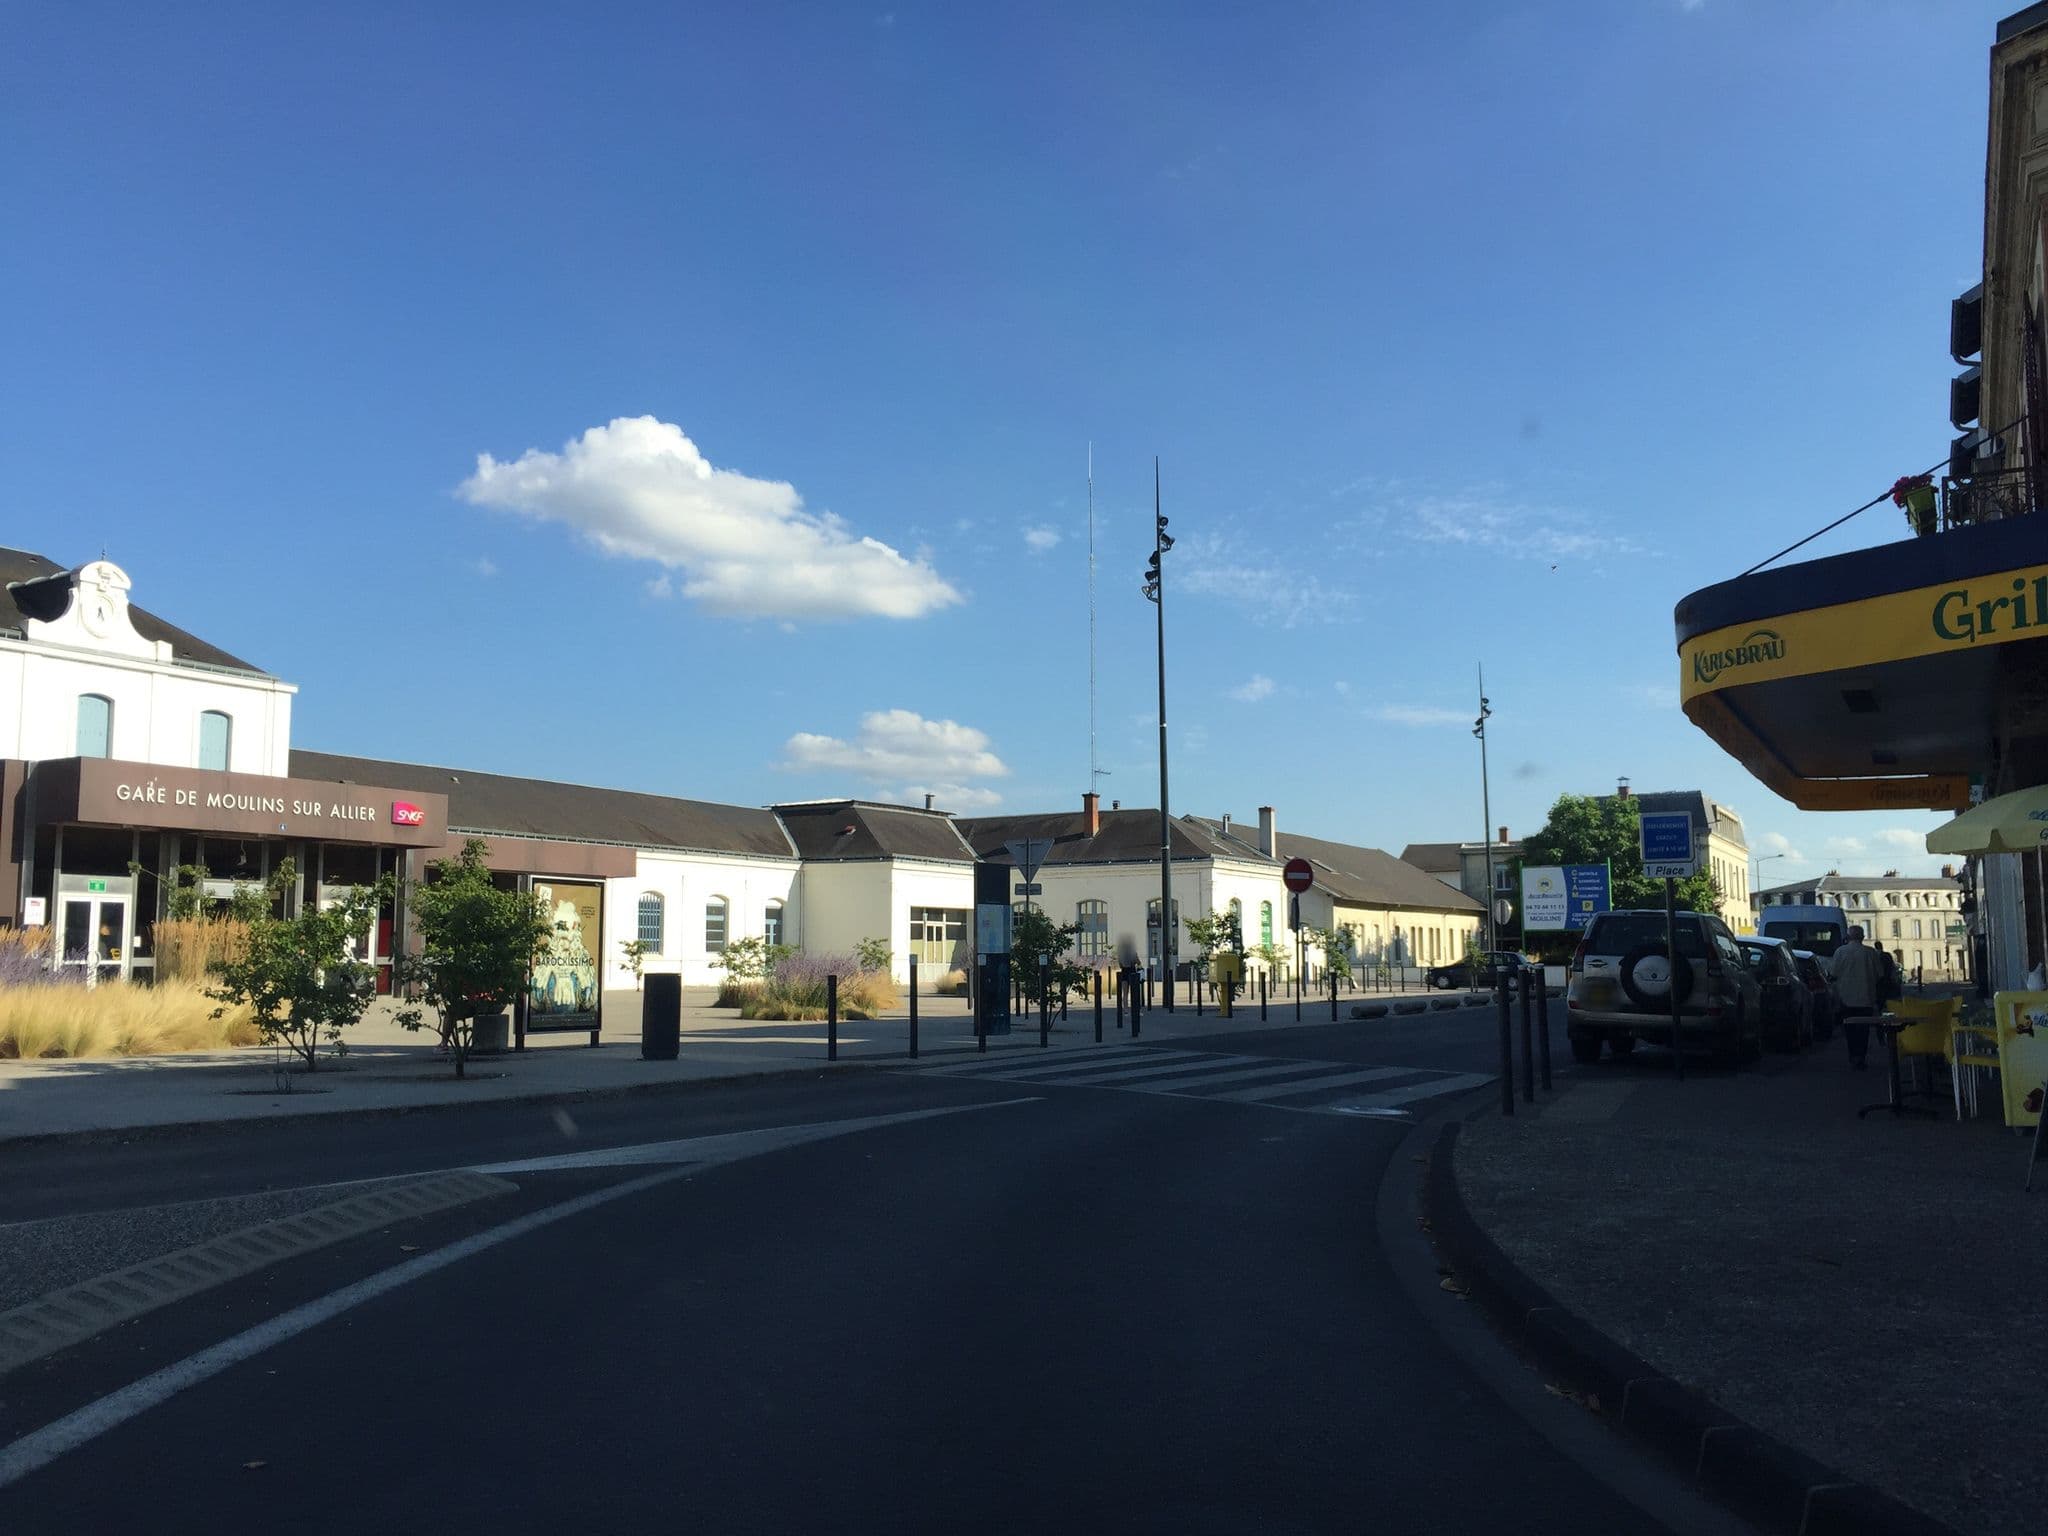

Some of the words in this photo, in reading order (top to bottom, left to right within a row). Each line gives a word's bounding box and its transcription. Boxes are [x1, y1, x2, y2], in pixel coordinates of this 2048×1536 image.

[1694, 638, 1785, 683] KARLSBRÄU
[116, 784, 166, 804] GARE
[175, 790, 197, 806] DE
[206, 793, 285, 814] MOULINS
[292, 800, 322, 817] SUR
[330, 804, 376, 822] ALLIER
[397, 808, 424, 822] SNCF
[1655, 866, 1685, 876] Place
[535, 955, 595, 968] BAROCKISSIMO
